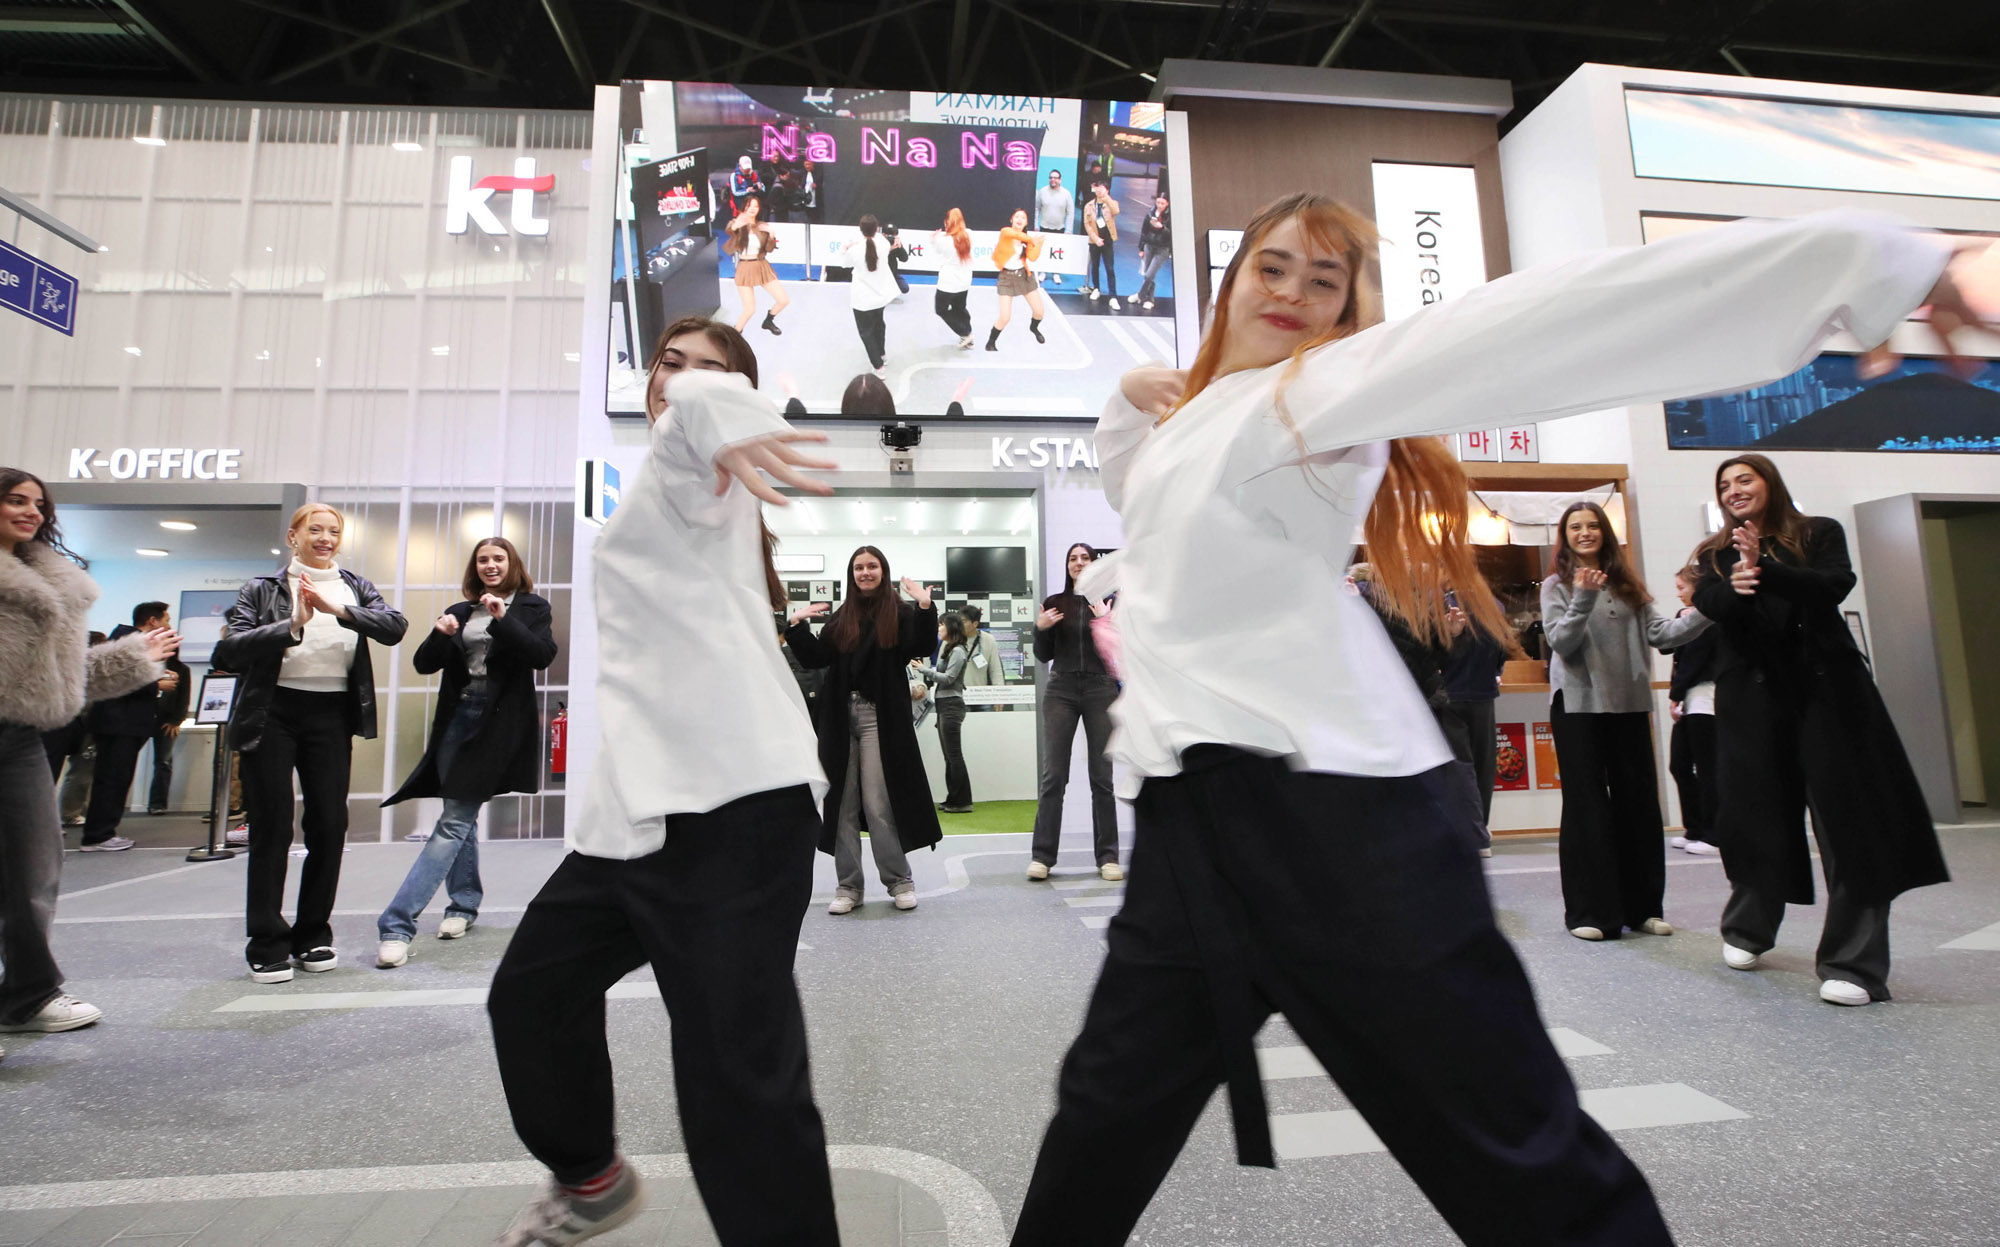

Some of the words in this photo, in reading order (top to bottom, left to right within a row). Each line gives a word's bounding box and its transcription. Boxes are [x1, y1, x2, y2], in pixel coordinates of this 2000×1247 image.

[762, 123, 836, 162] Na
[861, 128, 937, 167] Na
[961, 131, 1037, 171] Na
[445, 155, 555, 235] kt
[908, 243, 923, 257] kt
[1049, 247, 1065, 260] kt
[0, 269, 20, 288] ge
[1441, 430, 1531, 455] 마차
[69, 448, 241, 480] K-OFFICE
[816, 585, 827, 594] kt
[1017, 606, 1028, 615] kt
